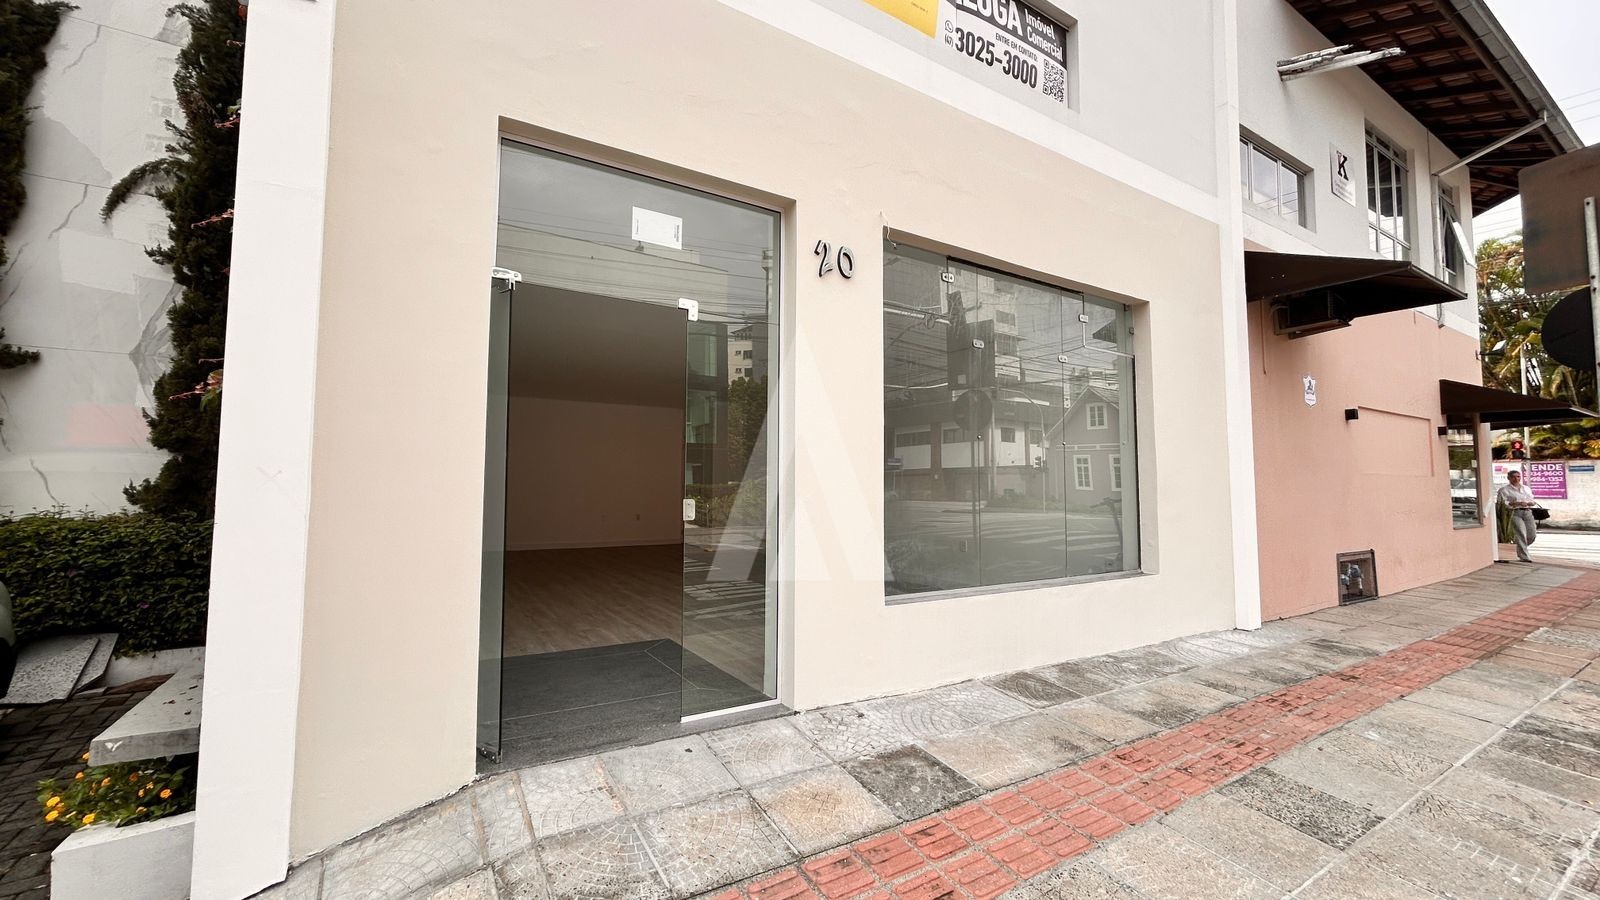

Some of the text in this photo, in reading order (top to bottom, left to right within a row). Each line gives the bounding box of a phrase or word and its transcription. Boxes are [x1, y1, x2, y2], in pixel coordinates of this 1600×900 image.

[995, 32, 1010, 47] ENTRE
[1011, 41, 1018, 51] EM
[1025, 8, 1056, 40] Imóvel
[955, 27, 1038, 89] 3025-3000
[1027, 26, 1064, 62] Comercial
[813, 239, 855, 279] 20
